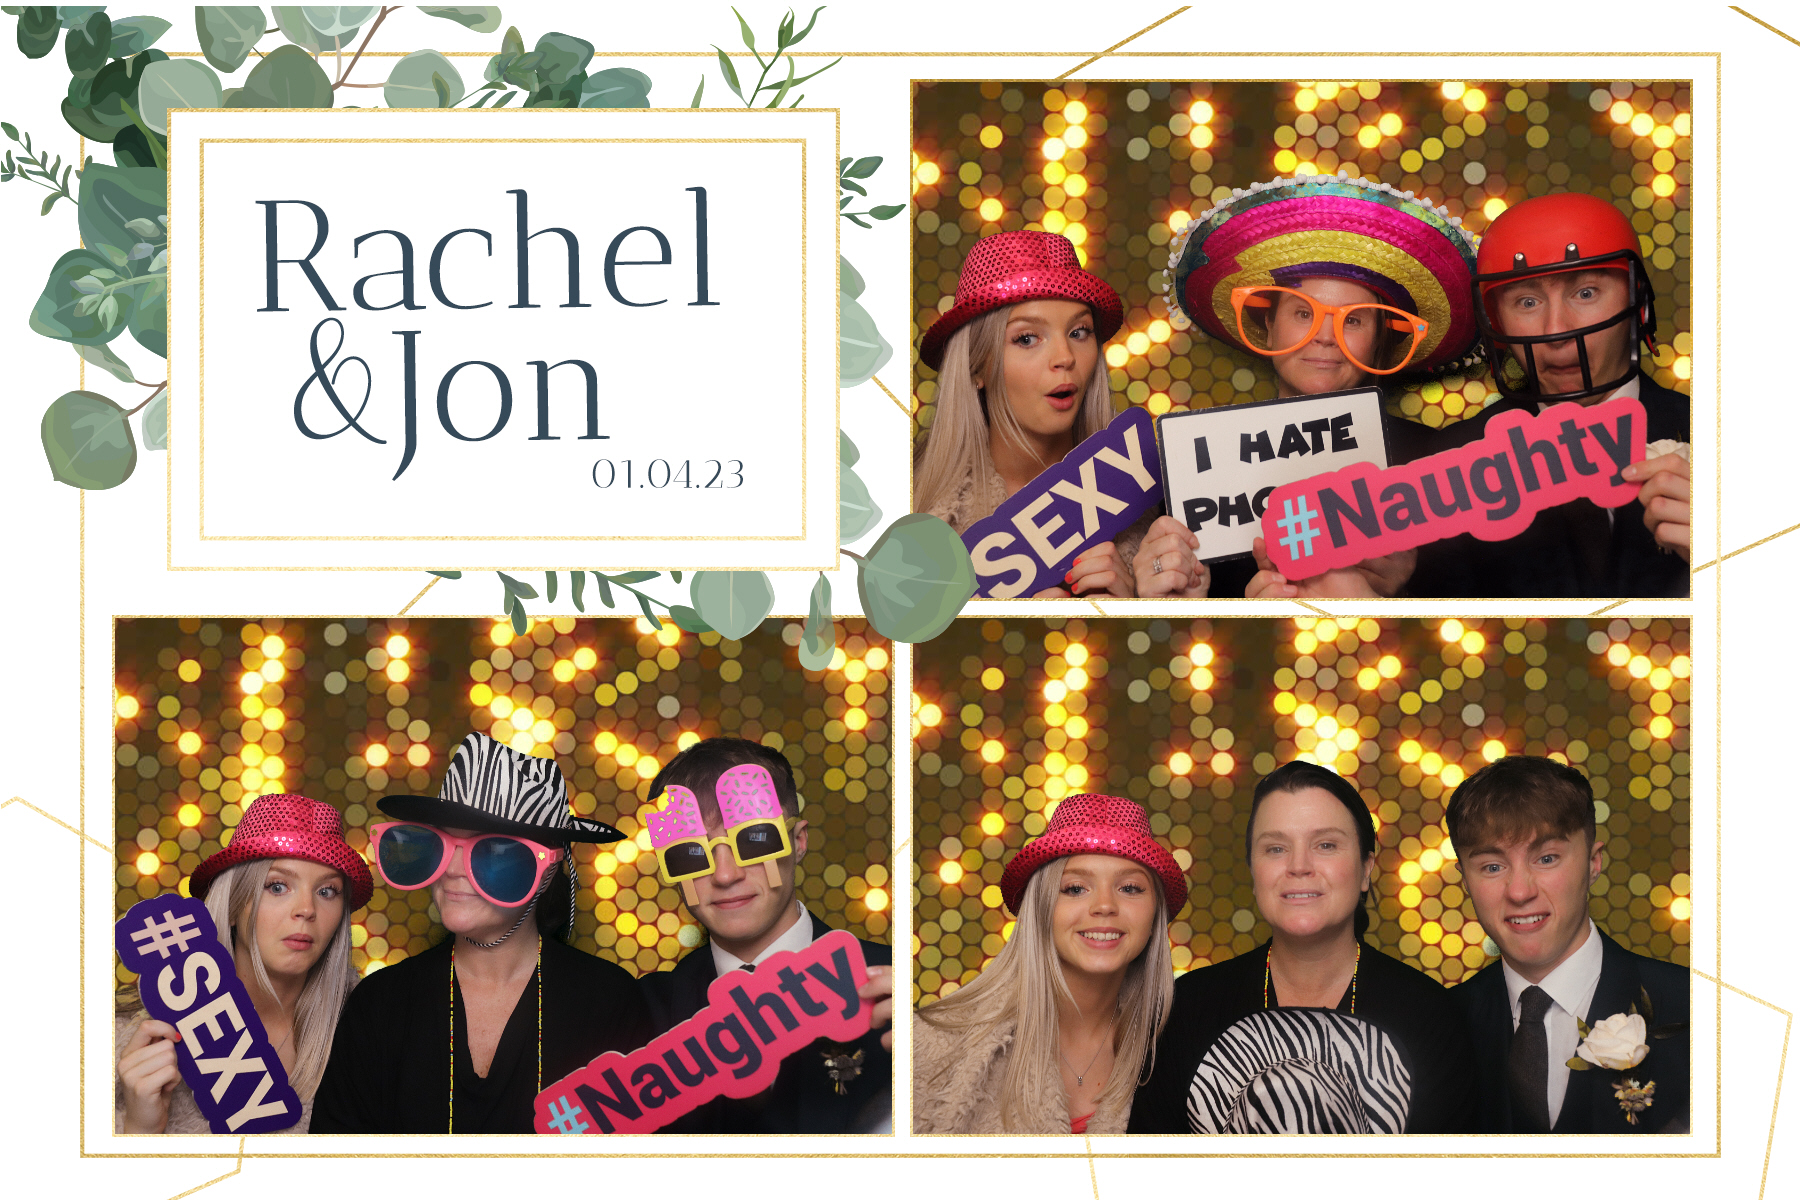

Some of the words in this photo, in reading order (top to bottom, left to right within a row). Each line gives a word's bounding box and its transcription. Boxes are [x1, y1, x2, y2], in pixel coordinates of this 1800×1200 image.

[1194, 436, 1212, 473] I
[1240, 412, 1359, 464] HATE
[1276, 413, 1633, 561] #Naughty
[130, 909, 289, 1133] #SEXY
[547, 945, 861, 1135] #Naughty
